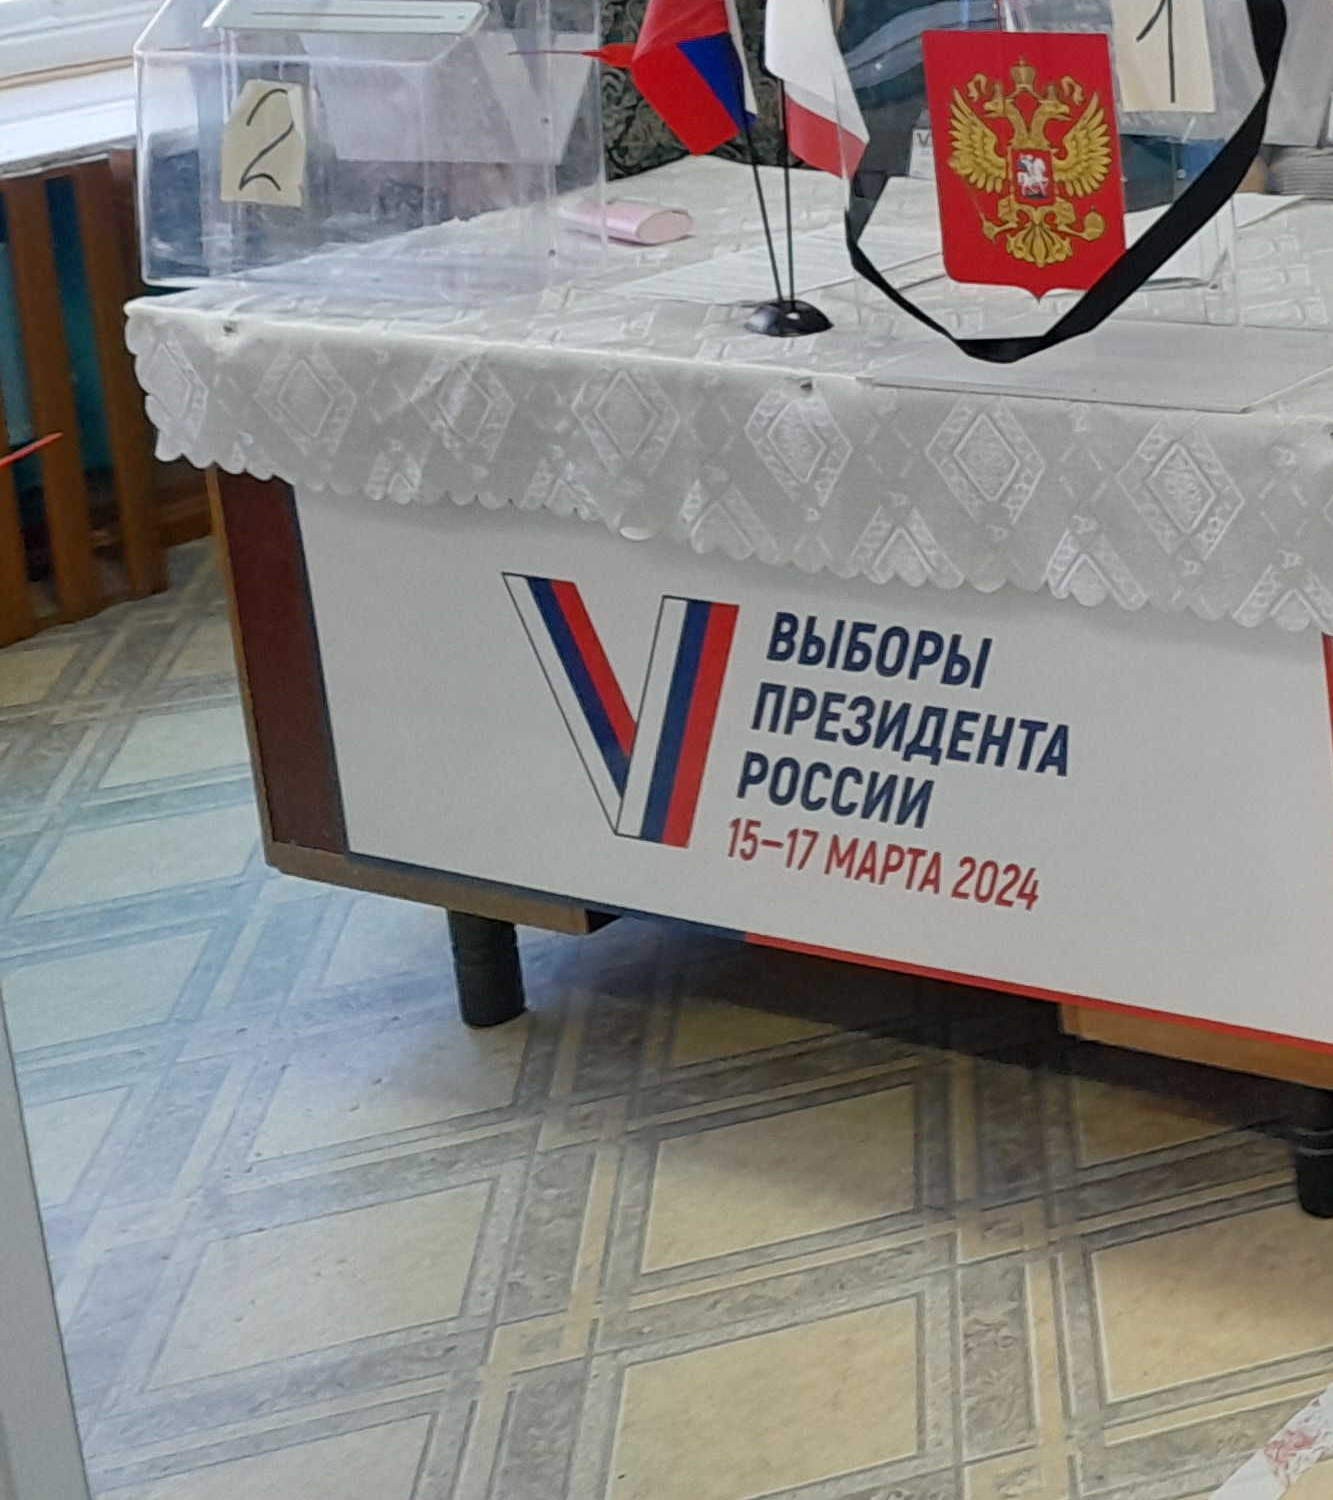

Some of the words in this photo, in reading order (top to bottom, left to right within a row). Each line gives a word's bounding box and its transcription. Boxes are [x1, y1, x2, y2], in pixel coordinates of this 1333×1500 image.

[238, 88, 295, 191] 2
[766, 611, 993, 689] ВЫБОРЫ
[751, 681, 1071, 776] ПРЕЗИДЕНТА
[736, 751, 936, 828] РОССИИ
[823, 834, 941, 894] МАРТА
[951, 856, 1040, 911] 2024
